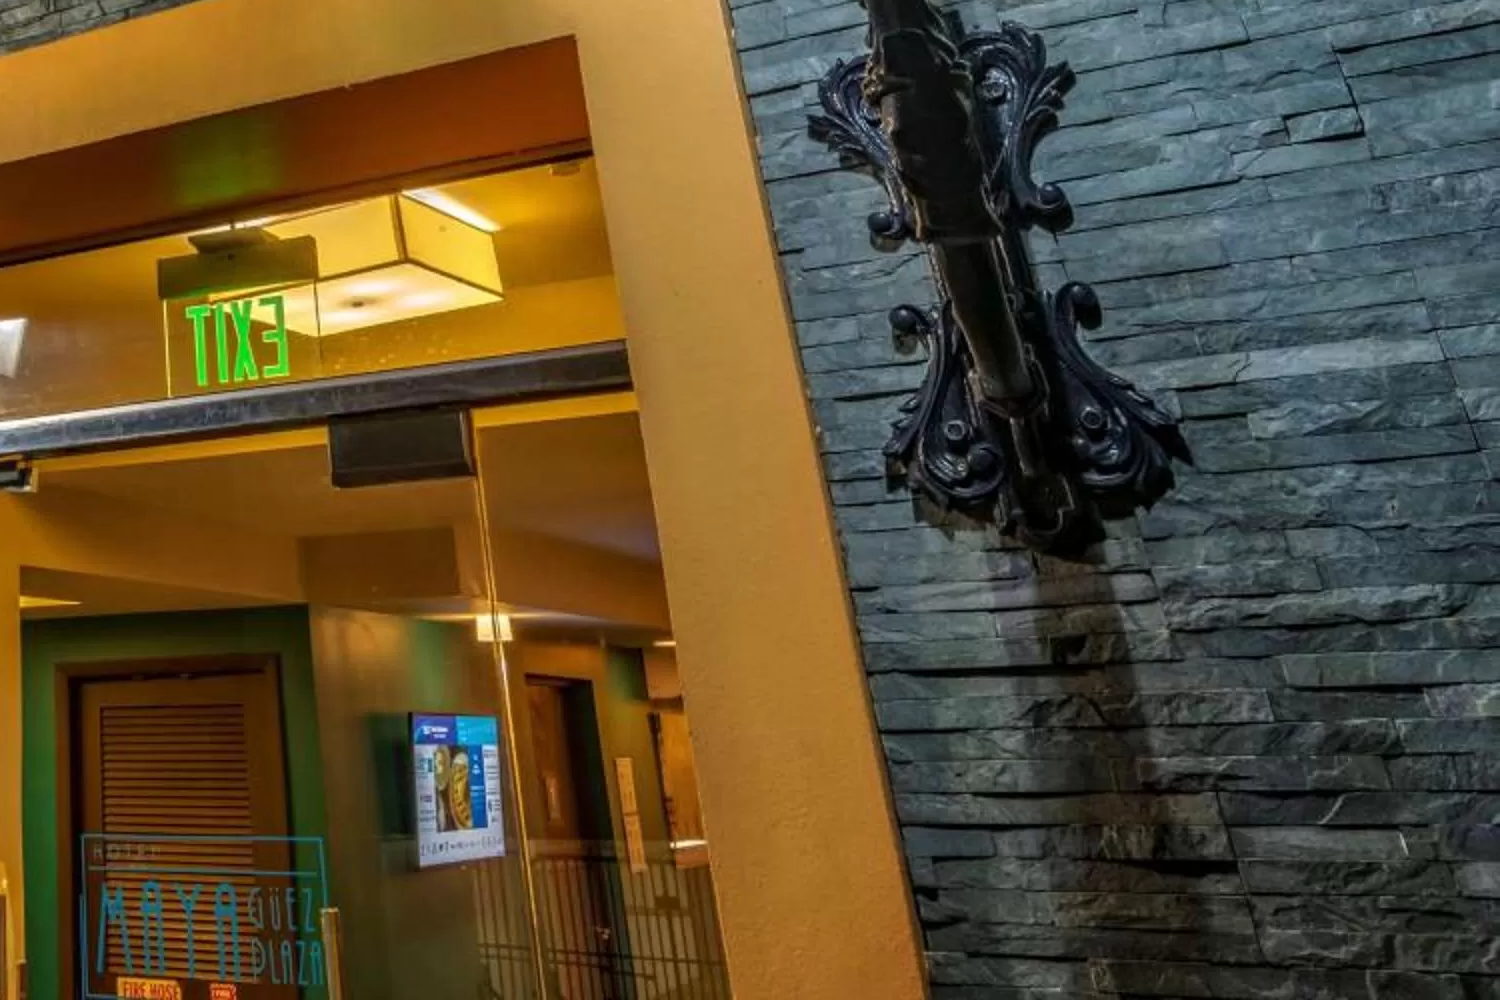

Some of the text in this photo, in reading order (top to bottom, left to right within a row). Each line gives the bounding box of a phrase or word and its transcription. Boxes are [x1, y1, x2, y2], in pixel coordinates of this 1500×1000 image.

[97, 880, 316, 981] MAYA GÜEZ
[251, 938, 324, 985] PLAZA
